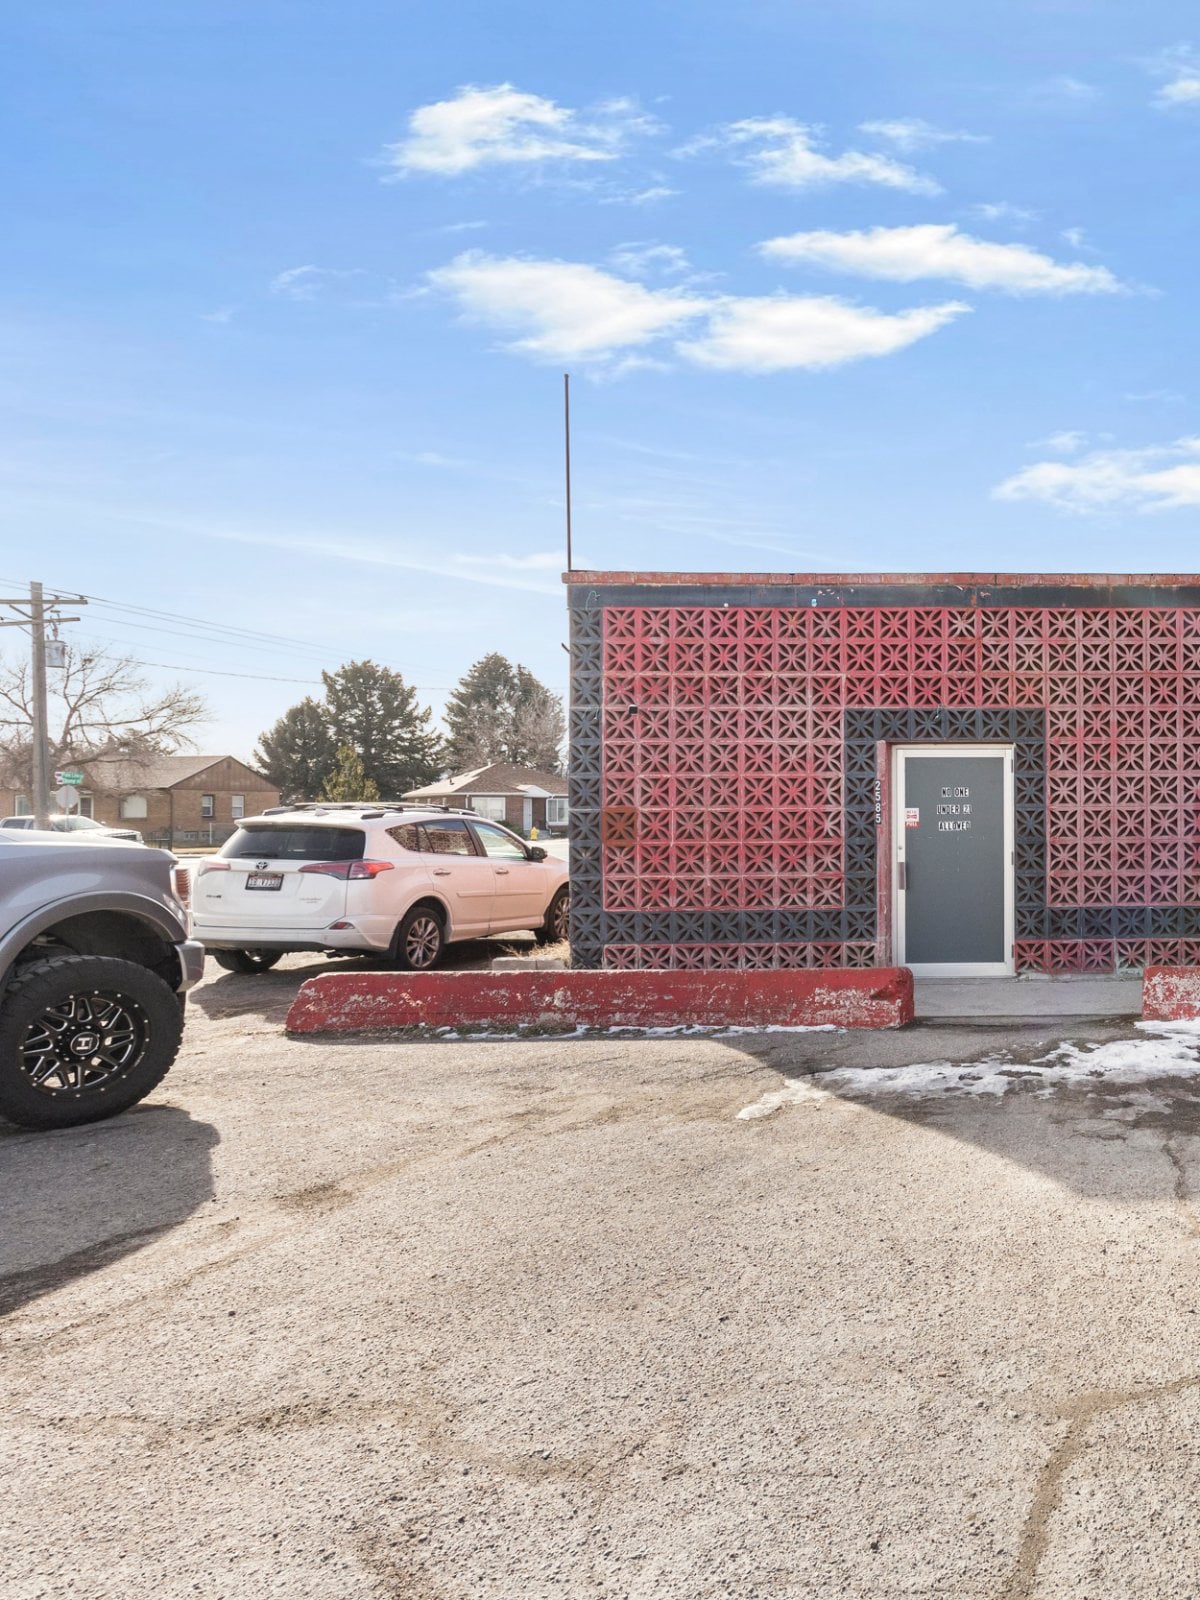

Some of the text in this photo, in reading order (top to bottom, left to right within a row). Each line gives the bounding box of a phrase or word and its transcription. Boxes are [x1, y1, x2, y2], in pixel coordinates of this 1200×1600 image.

[942, 787, 969, 797] NO ONE
[937, 804, 960, 814] UNDER
[939, 821, 971, 831] ALLOWED
